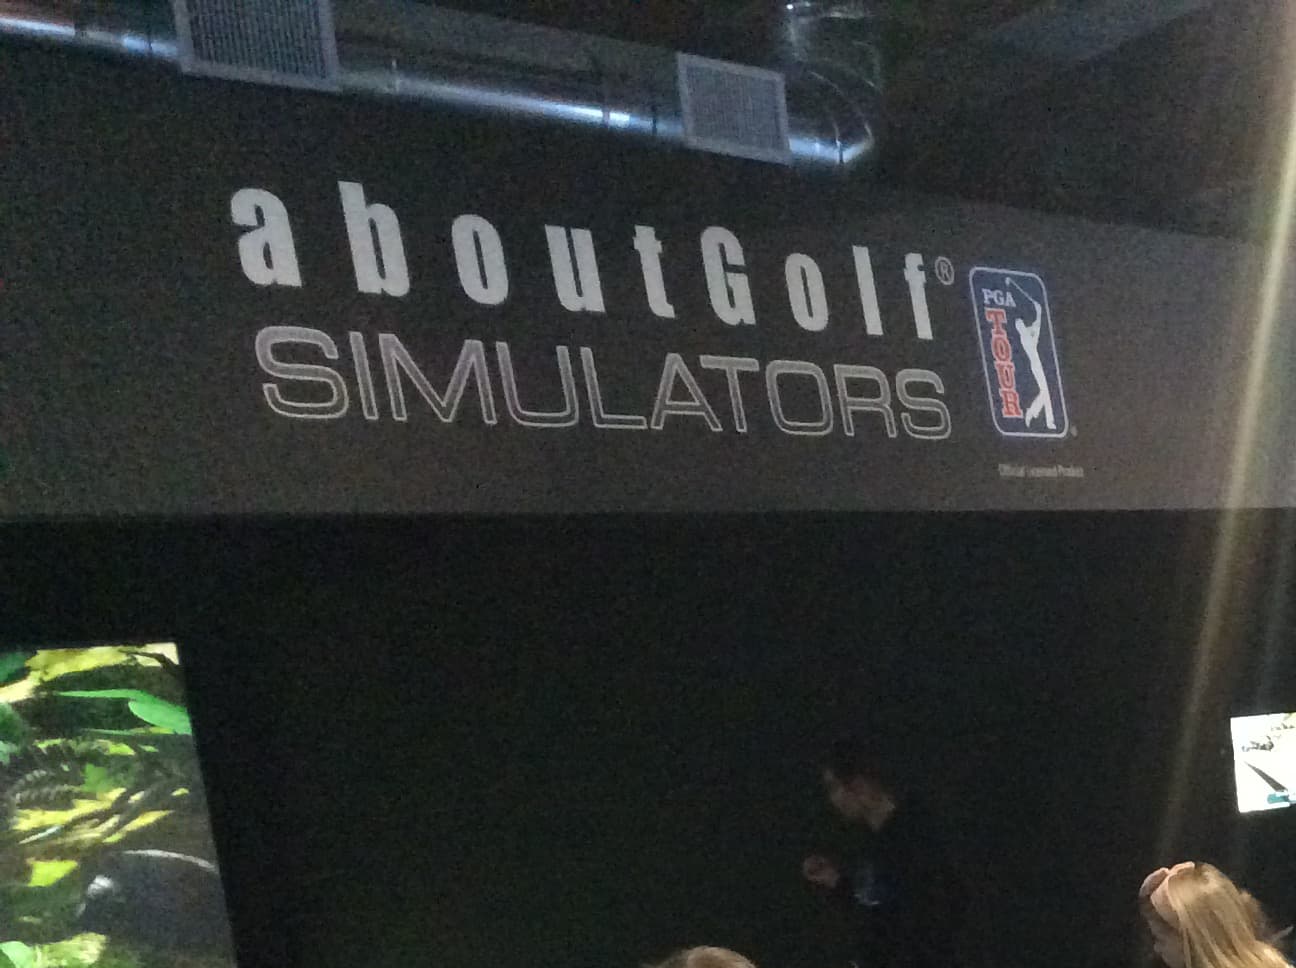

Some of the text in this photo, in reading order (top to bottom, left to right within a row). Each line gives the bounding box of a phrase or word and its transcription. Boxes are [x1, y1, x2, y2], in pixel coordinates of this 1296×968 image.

[981, 287, 1017, 308] PGA
[254, 325, 952, 440] SIMULATORS
[984, 306, 1024, 419] TOUR
